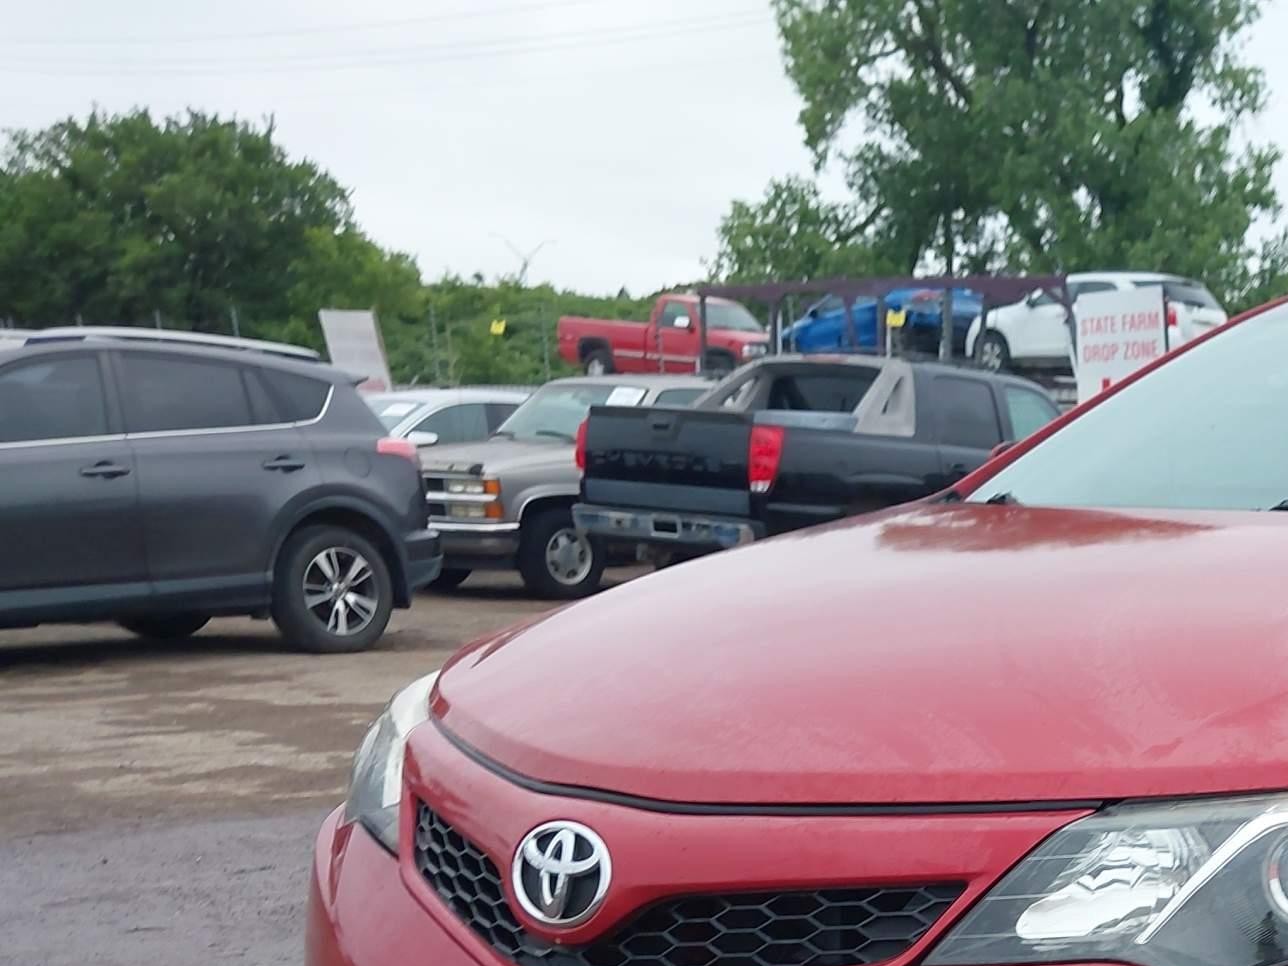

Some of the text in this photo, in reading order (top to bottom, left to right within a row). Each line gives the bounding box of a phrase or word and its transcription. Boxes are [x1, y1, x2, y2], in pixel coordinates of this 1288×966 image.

[1080, 310, 1160, 336] STATE FARM
[1083, 339, 1158, 363] DROP ZONE
